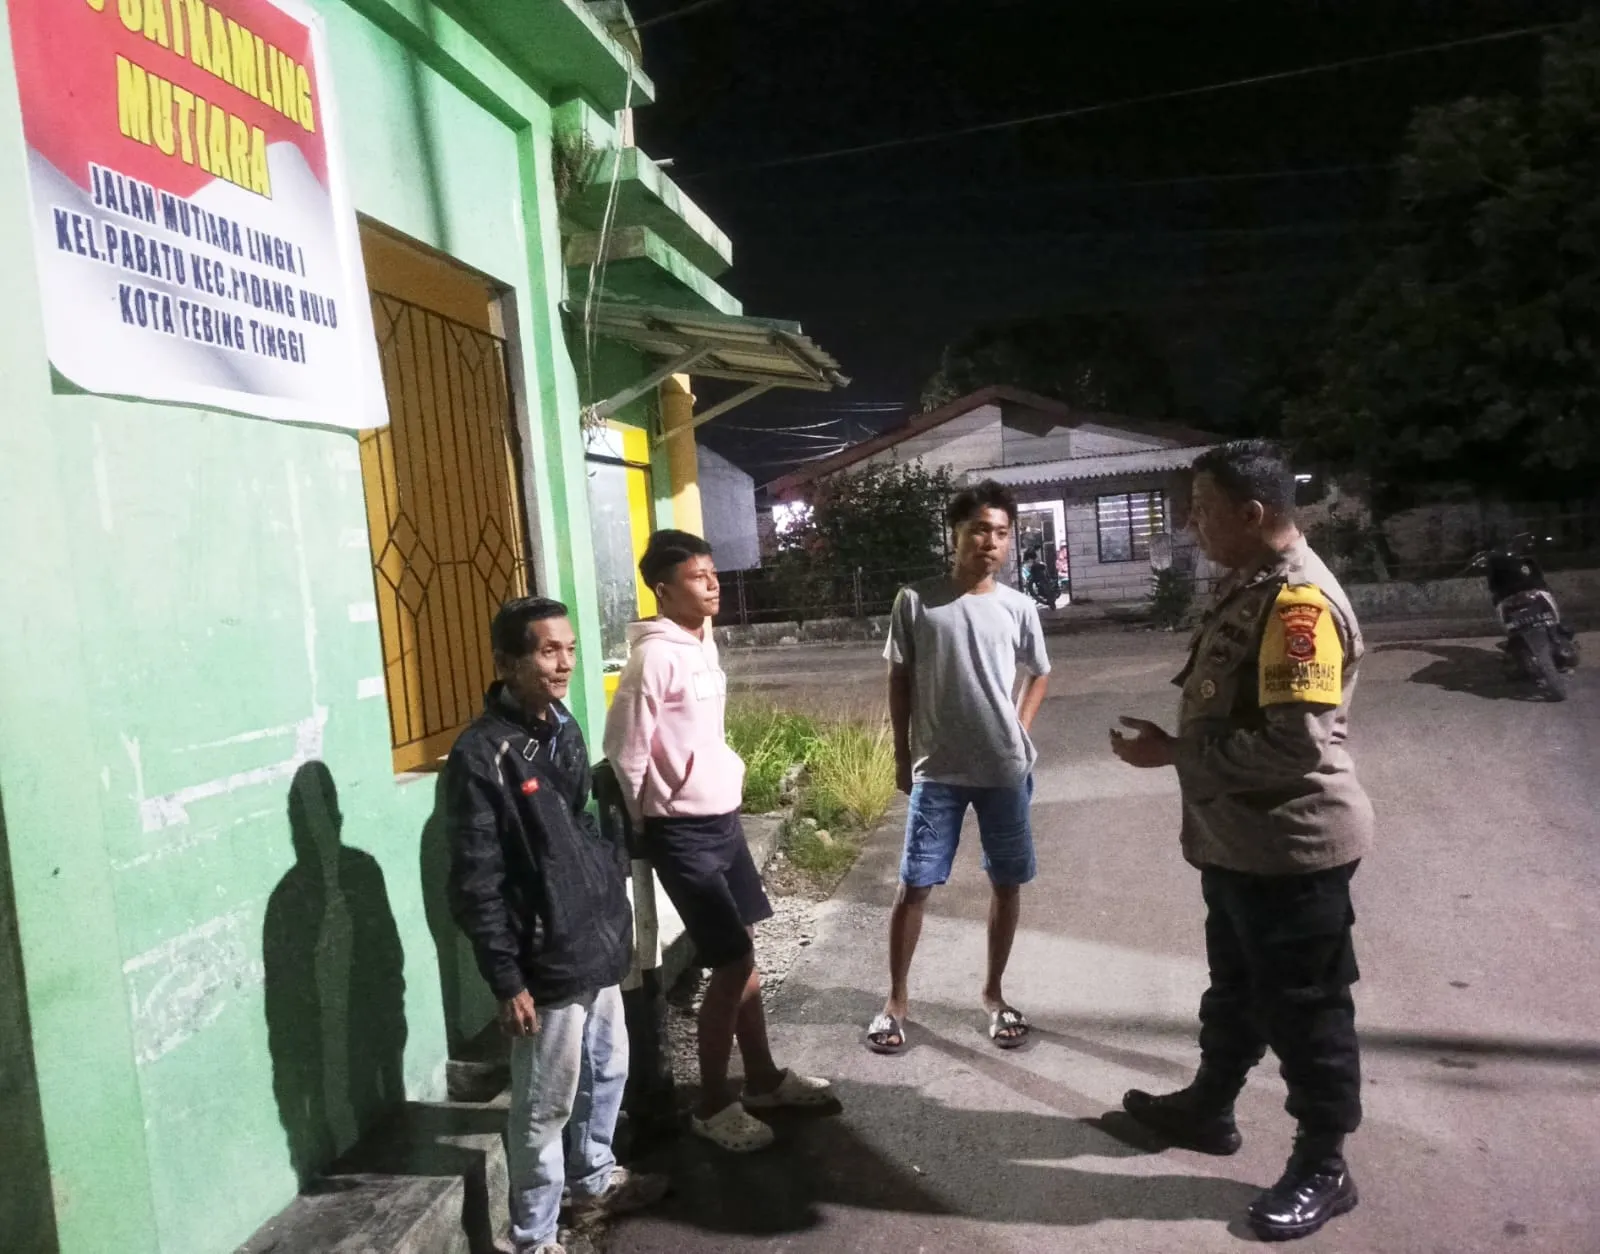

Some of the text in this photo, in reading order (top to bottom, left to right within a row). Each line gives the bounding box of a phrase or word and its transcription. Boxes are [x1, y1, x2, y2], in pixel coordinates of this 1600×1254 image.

[115, 52, 272, 200] MUTIARA
[54, 208, 338, 330] KEL.PABATU KEC.PADANG HULU
[93, 166, 156, 225] JALAN
[161, 193, 244, 257] MUTIARA
[246, 227, 296, 274] LINGK
[119, 283, 306, 365] KOTA TEBING TINGGI
